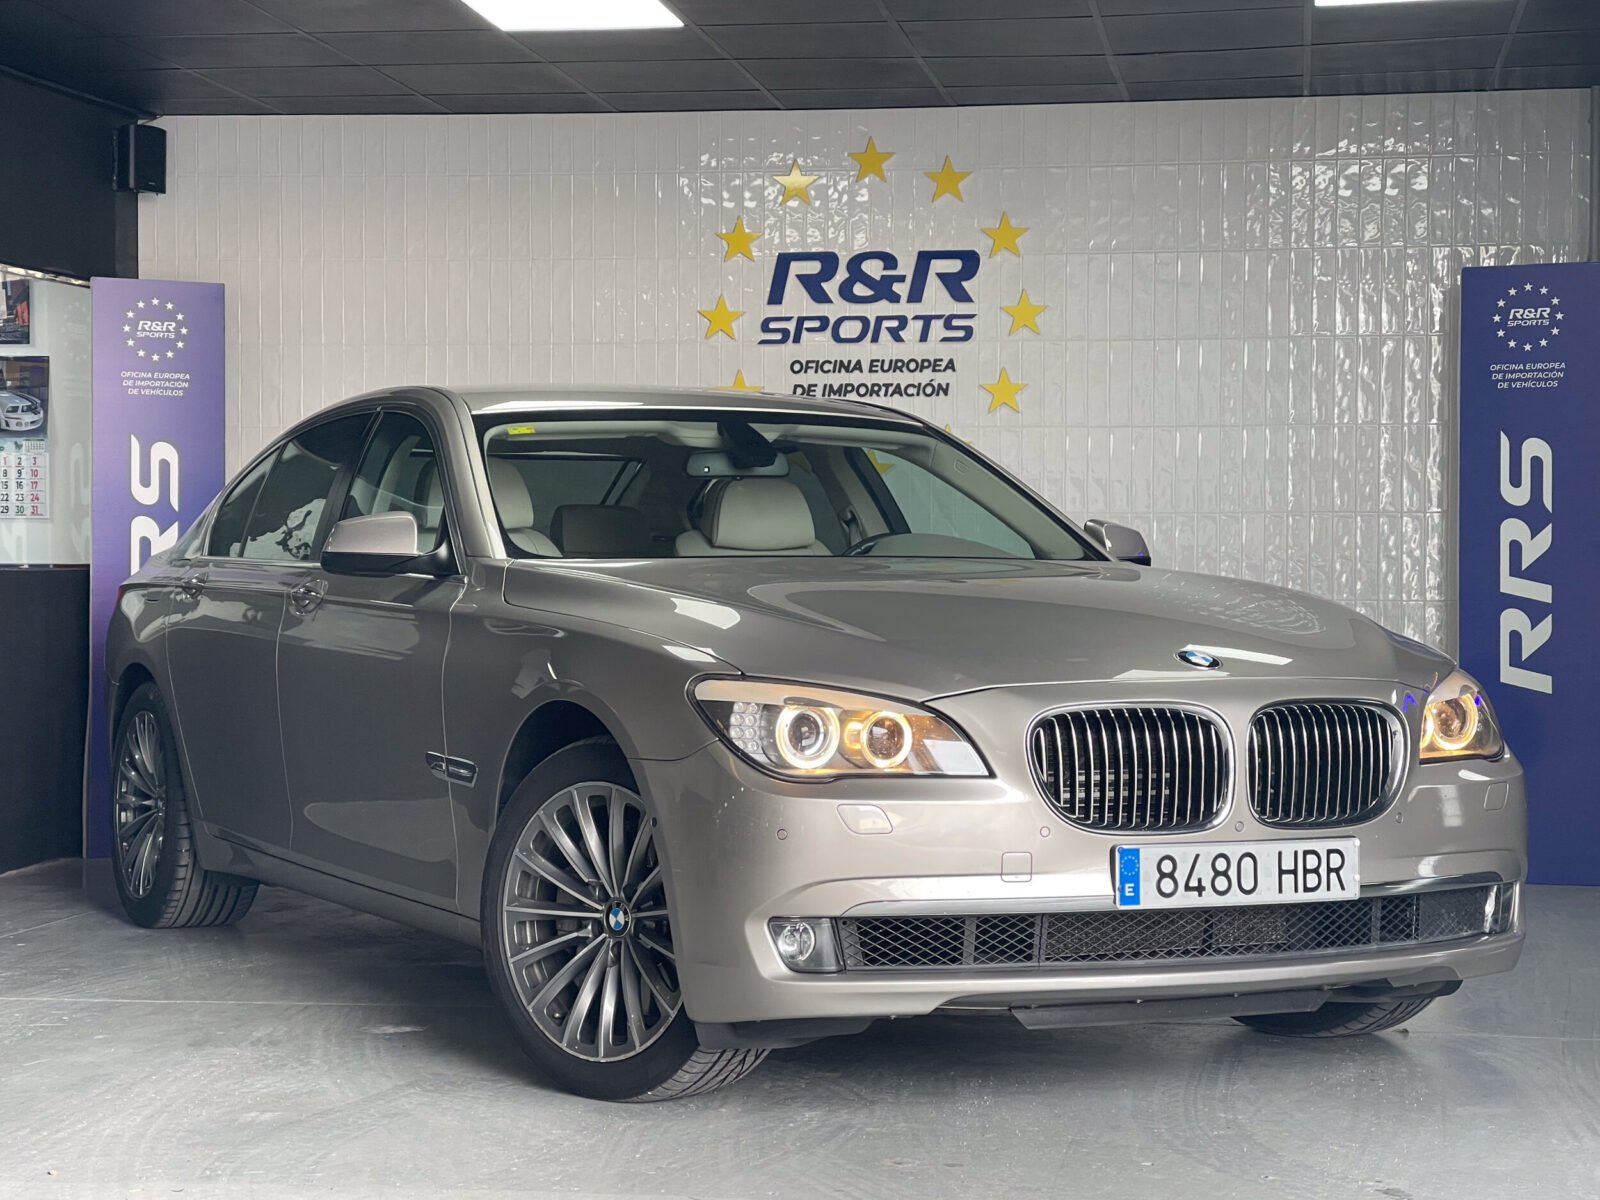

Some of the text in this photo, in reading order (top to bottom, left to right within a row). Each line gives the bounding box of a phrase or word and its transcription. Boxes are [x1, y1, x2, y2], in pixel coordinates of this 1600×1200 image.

[767, 250, 981, 305] R&R
[1508, 307, 1551, 320] R&R
[137, 320, 176, 332] R&R
[1507, 319, 1550, 327] SPORTS
[757, 313, 978, 345] SPORTS
[136, 331, 176, 339] SPORTS
[789, 358, 957, 374] OFICINA EUROPEA
[1489, 362, 1566, 371] OFICINA EUROPEA
[120, 371, 190, 380] OFICINA EUROPEA
[1505, 371, 1564, 379] IMPORTACIÓN
[122, 379, 189, 388] DE IMPORTACIÓN
[792, 378, 950, 398] DE IMPORTACIÓN
[1511, 379, 1559, 388] VEHÍCULOS
[140, 387, 184, 396] VEHÍCULOS
[30, 468, 39, 478] 10
[1, 481, 38, 490] 15 16 17
[0, 493, 40, 502] 22 23 24
[0, 505, 39, 515] 29 30 31
[1499, 430, 1553, 695] RRS
[1155, 848, 1346, 898] 8480 HBR
[1125, 883, 1135, 897] E
